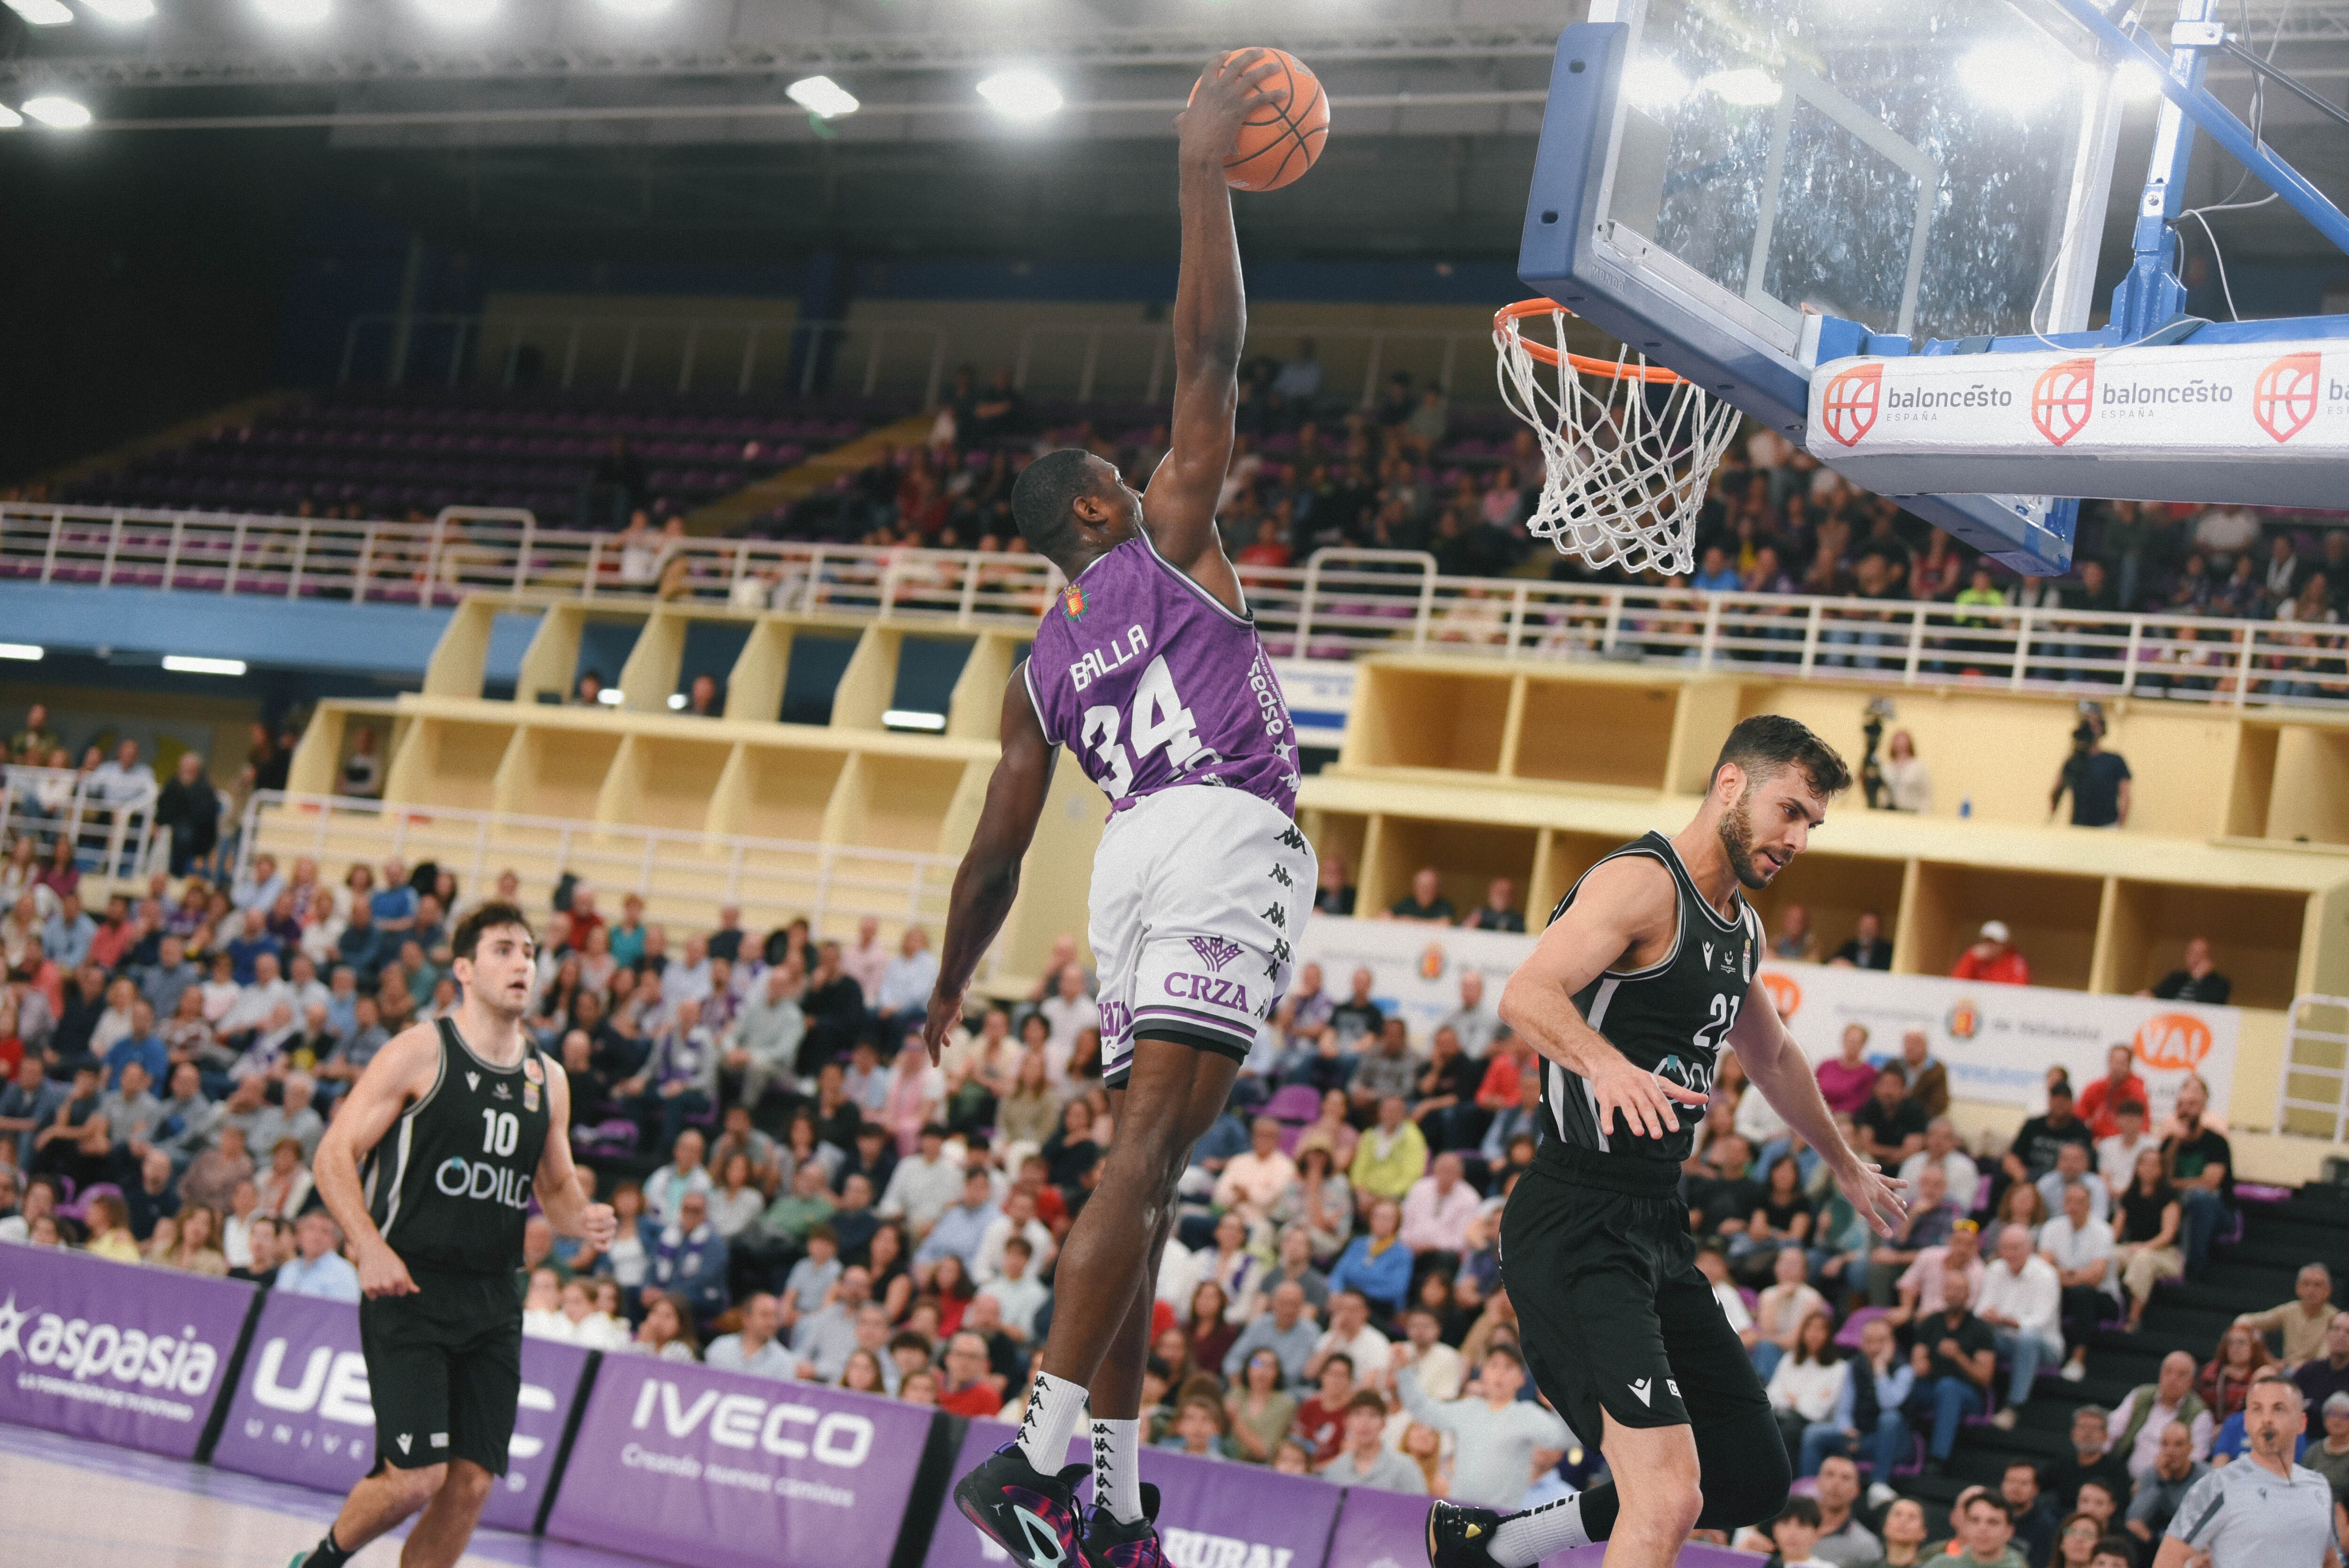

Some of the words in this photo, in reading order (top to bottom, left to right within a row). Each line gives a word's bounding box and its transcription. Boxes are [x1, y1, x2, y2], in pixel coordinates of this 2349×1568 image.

[1886, 411, 1937, 421] ESPAÑA
[2101, 407, 2155, 419] ESPAÑA
[1069, 624, 1149, 692] BALLA
[1081, 653, 1203, 800] 34
[1163, 971, 1250, 1014] CRZA
[1692, 993, 1740, 1051] 21
[482, 1107, 520, 1157] 10
[27, 1312, 218, 1396] aspasia
[631, 1378, 875, 1468] IVECO
